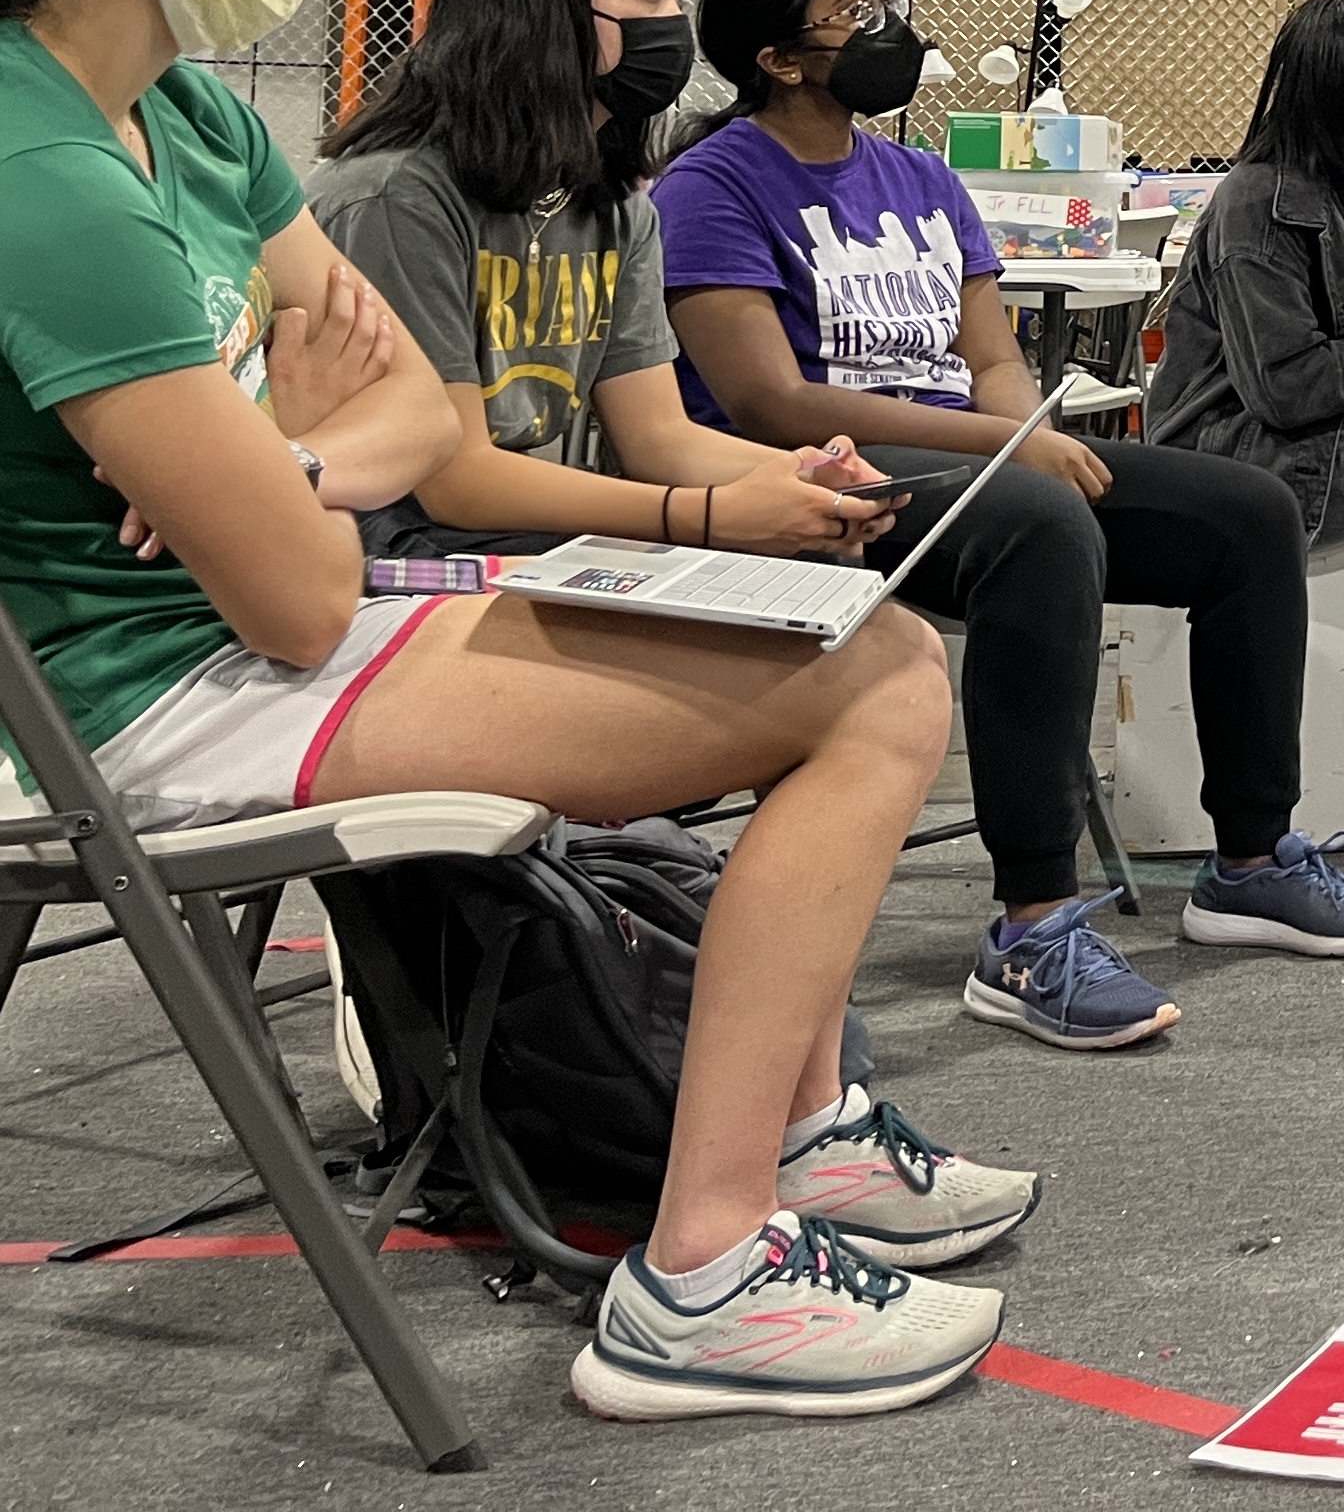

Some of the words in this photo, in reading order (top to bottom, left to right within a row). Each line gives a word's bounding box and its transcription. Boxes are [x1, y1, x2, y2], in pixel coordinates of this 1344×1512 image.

[987, 196, 1006, 210] Jr
[1016, 197, 1053, 214] FLL
[854, 373, 868, 385] THE
